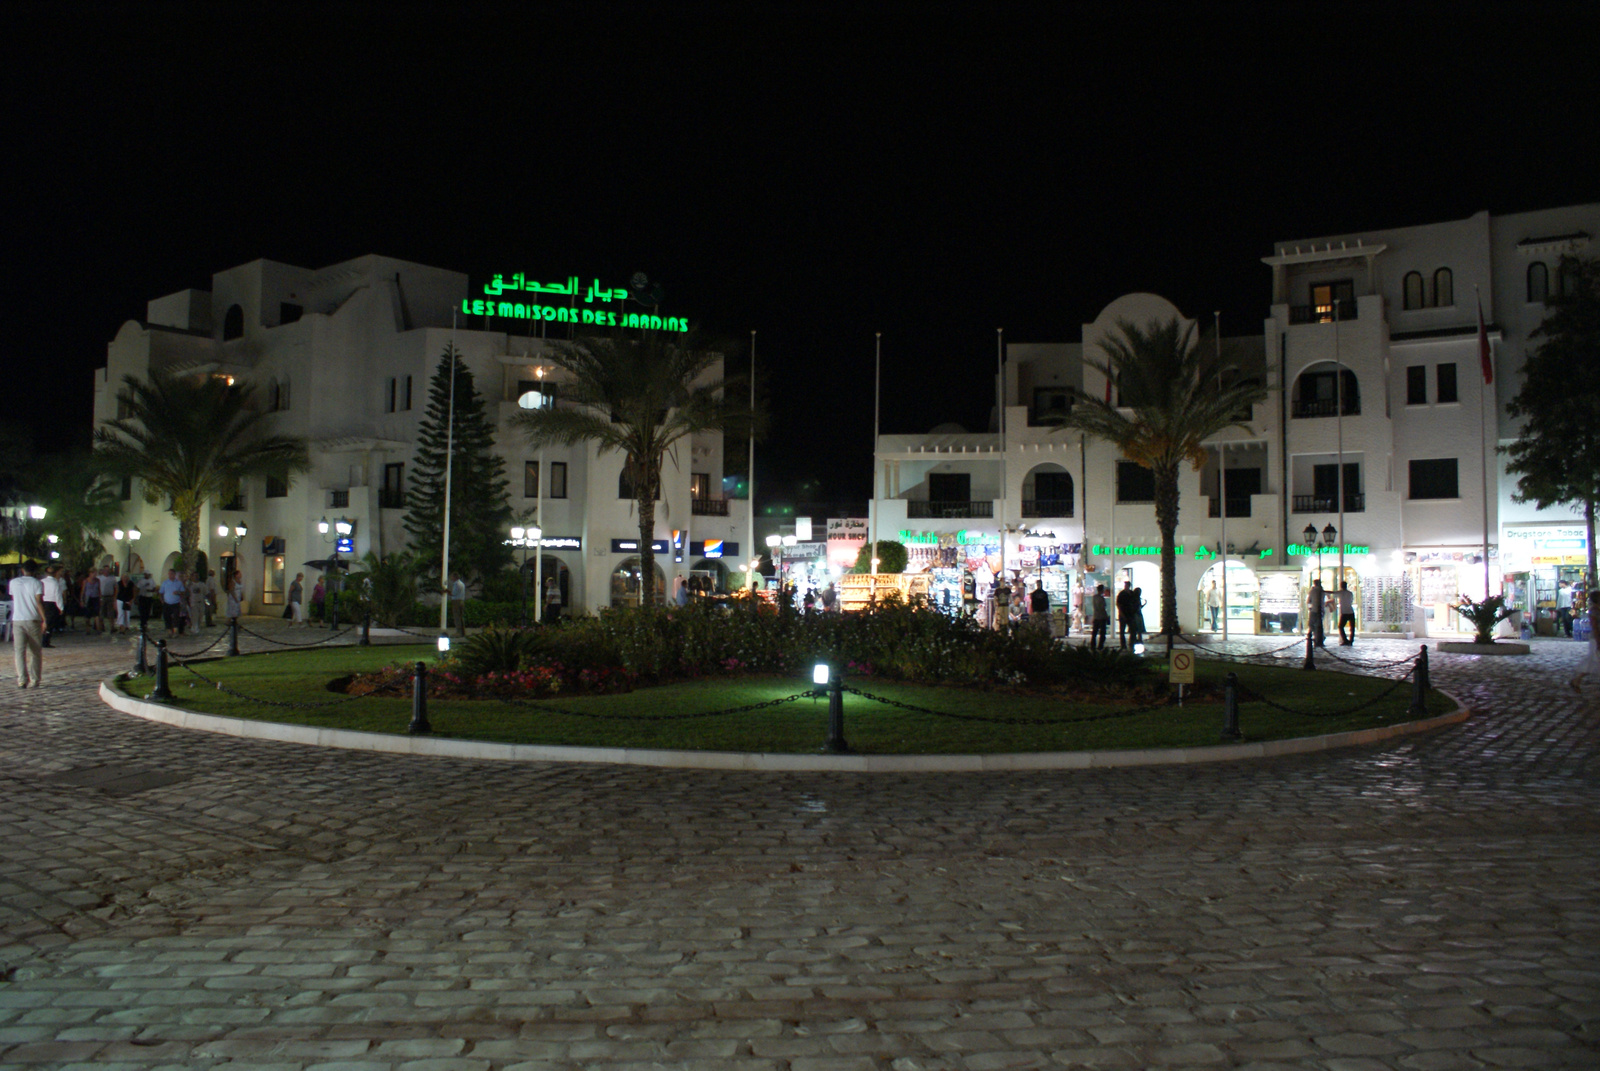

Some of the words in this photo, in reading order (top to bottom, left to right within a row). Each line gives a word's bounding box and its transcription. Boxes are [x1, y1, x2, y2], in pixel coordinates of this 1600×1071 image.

[484, 272, 579, 295] الحدائق
[584, 278, 628, 303] ديار
[462, 299, 495, 316] LES
[498, 302, 579, 323] MAISONS
[582, 309, 616, 326] DES
[620, 313, 688, 333] JARDINS
[1507, 530, 1552, 539] Drugstore
[1557, 529, 1584, 537] Tabac
[1092, 544, 1124, 556] Cenre
[1287, 543, 1313, 558] City
[1315, 543, 1369, 556] Jewllers
